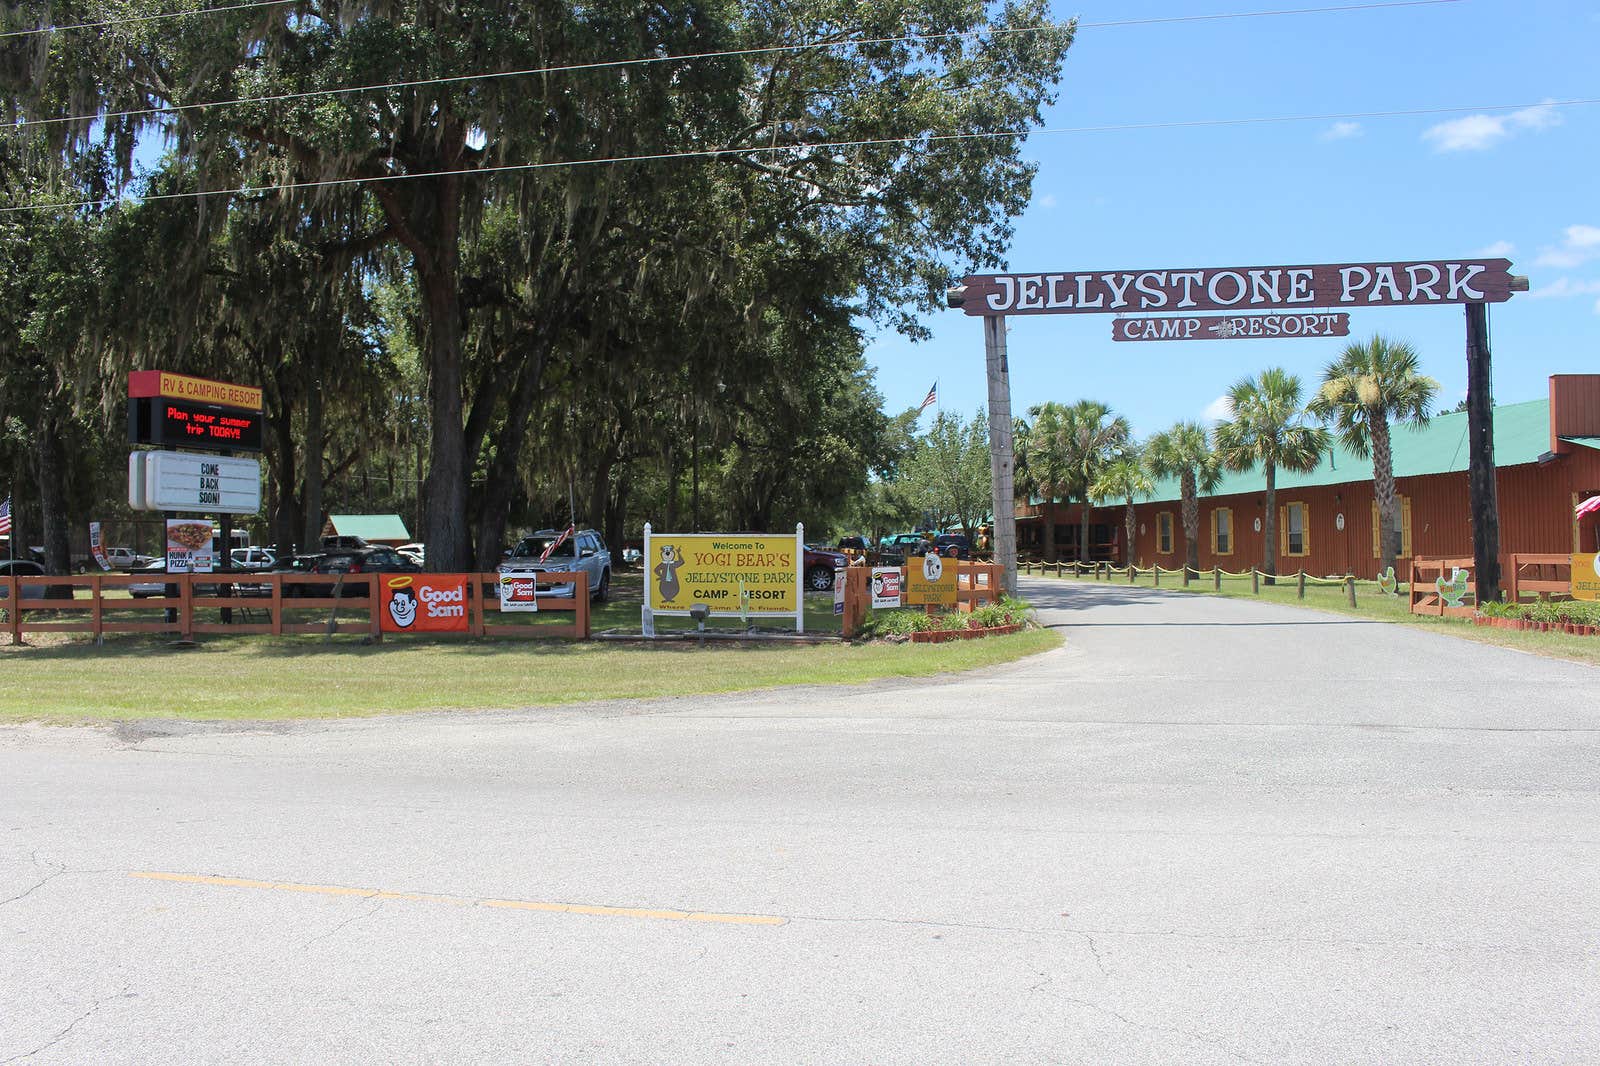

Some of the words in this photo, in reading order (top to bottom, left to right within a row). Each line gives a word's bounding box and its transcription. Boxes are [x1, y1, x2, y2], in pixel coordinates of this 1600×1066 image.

[986, 268, 1315, 311] JELLYSTONE
[1338, 263, 1485, 302] PARK
[1123, 318, 1201, 338] CAMP
[1231, 314, 1338, 336] RESORT
[163, 378, 175, 393] RV
[178, 380, 184, 394] &
[187, 382, 226, 400] CAMPING
[228, 388, 260, 405] RESORT
[167, 407, 188, 421] Plan
[193, 413, 215, 424] your
[220, 417, 251, 428] summer
[186, 423, 204, 435] trip
[201, 463, 219, 476] COME
[200, 477, 219, 490] BACK
[199, 492, 220, 505] SOON!
[712, 542, 753, 550] Welcome
[755, 542, 765, 550] To
[187, 551, 193, 560] A
[693, 552, 731, 567] YOGI
[737, 552, 791, 567] BEAR'S
[685, 572, 760, 584] JELLYSTONE
[763, 572, 795, 584] PARK
[883, 576, 899, 584] Good
[419, 585, 463, 603] Good
[693, 589, 729, 599] CAMP
[427, 602, 464, 617] Sam
